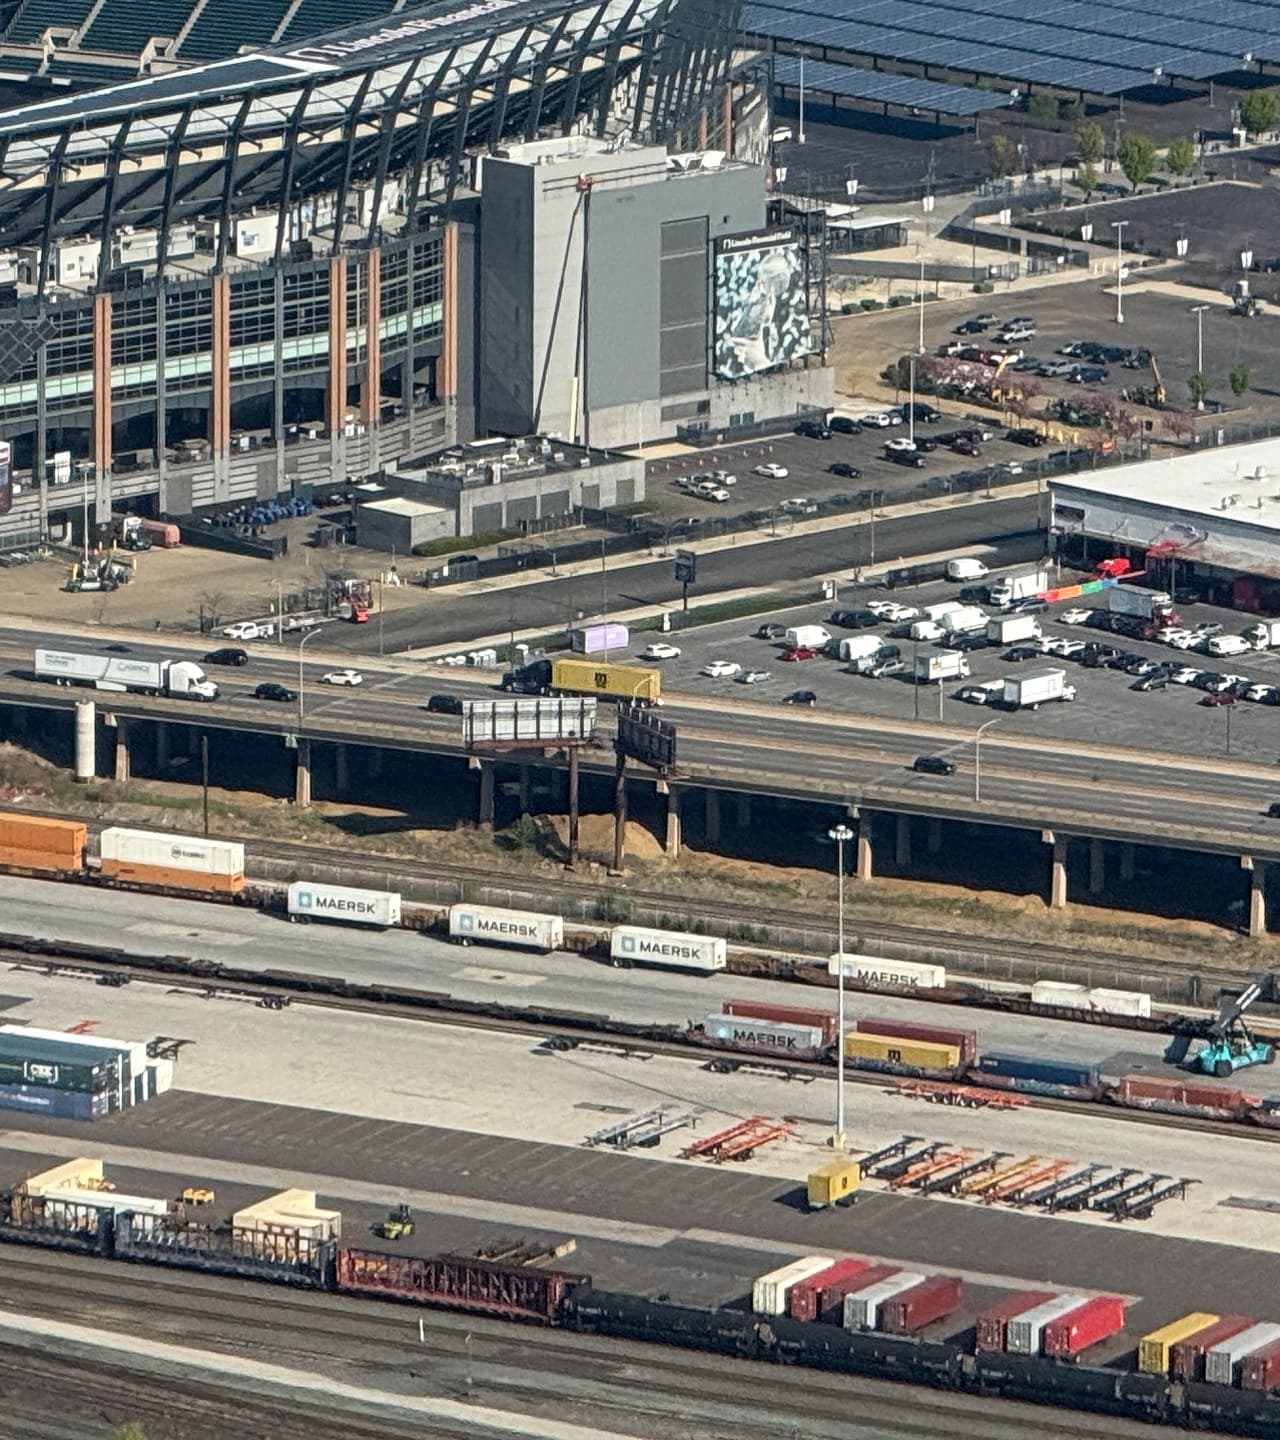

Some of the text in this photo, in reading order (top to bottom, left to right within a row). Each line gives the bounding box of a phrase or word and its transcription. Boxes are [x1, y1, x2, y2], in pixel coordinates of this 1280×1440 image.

[316, 895, 376, 914] MAERSK
[478, 918, 538, 938] MAERSK
[640, 941, 701, 960] MAERSK
[857, 968, 918, 987] MAERSK
[733, 1029, 796, 1049] MAERSK
